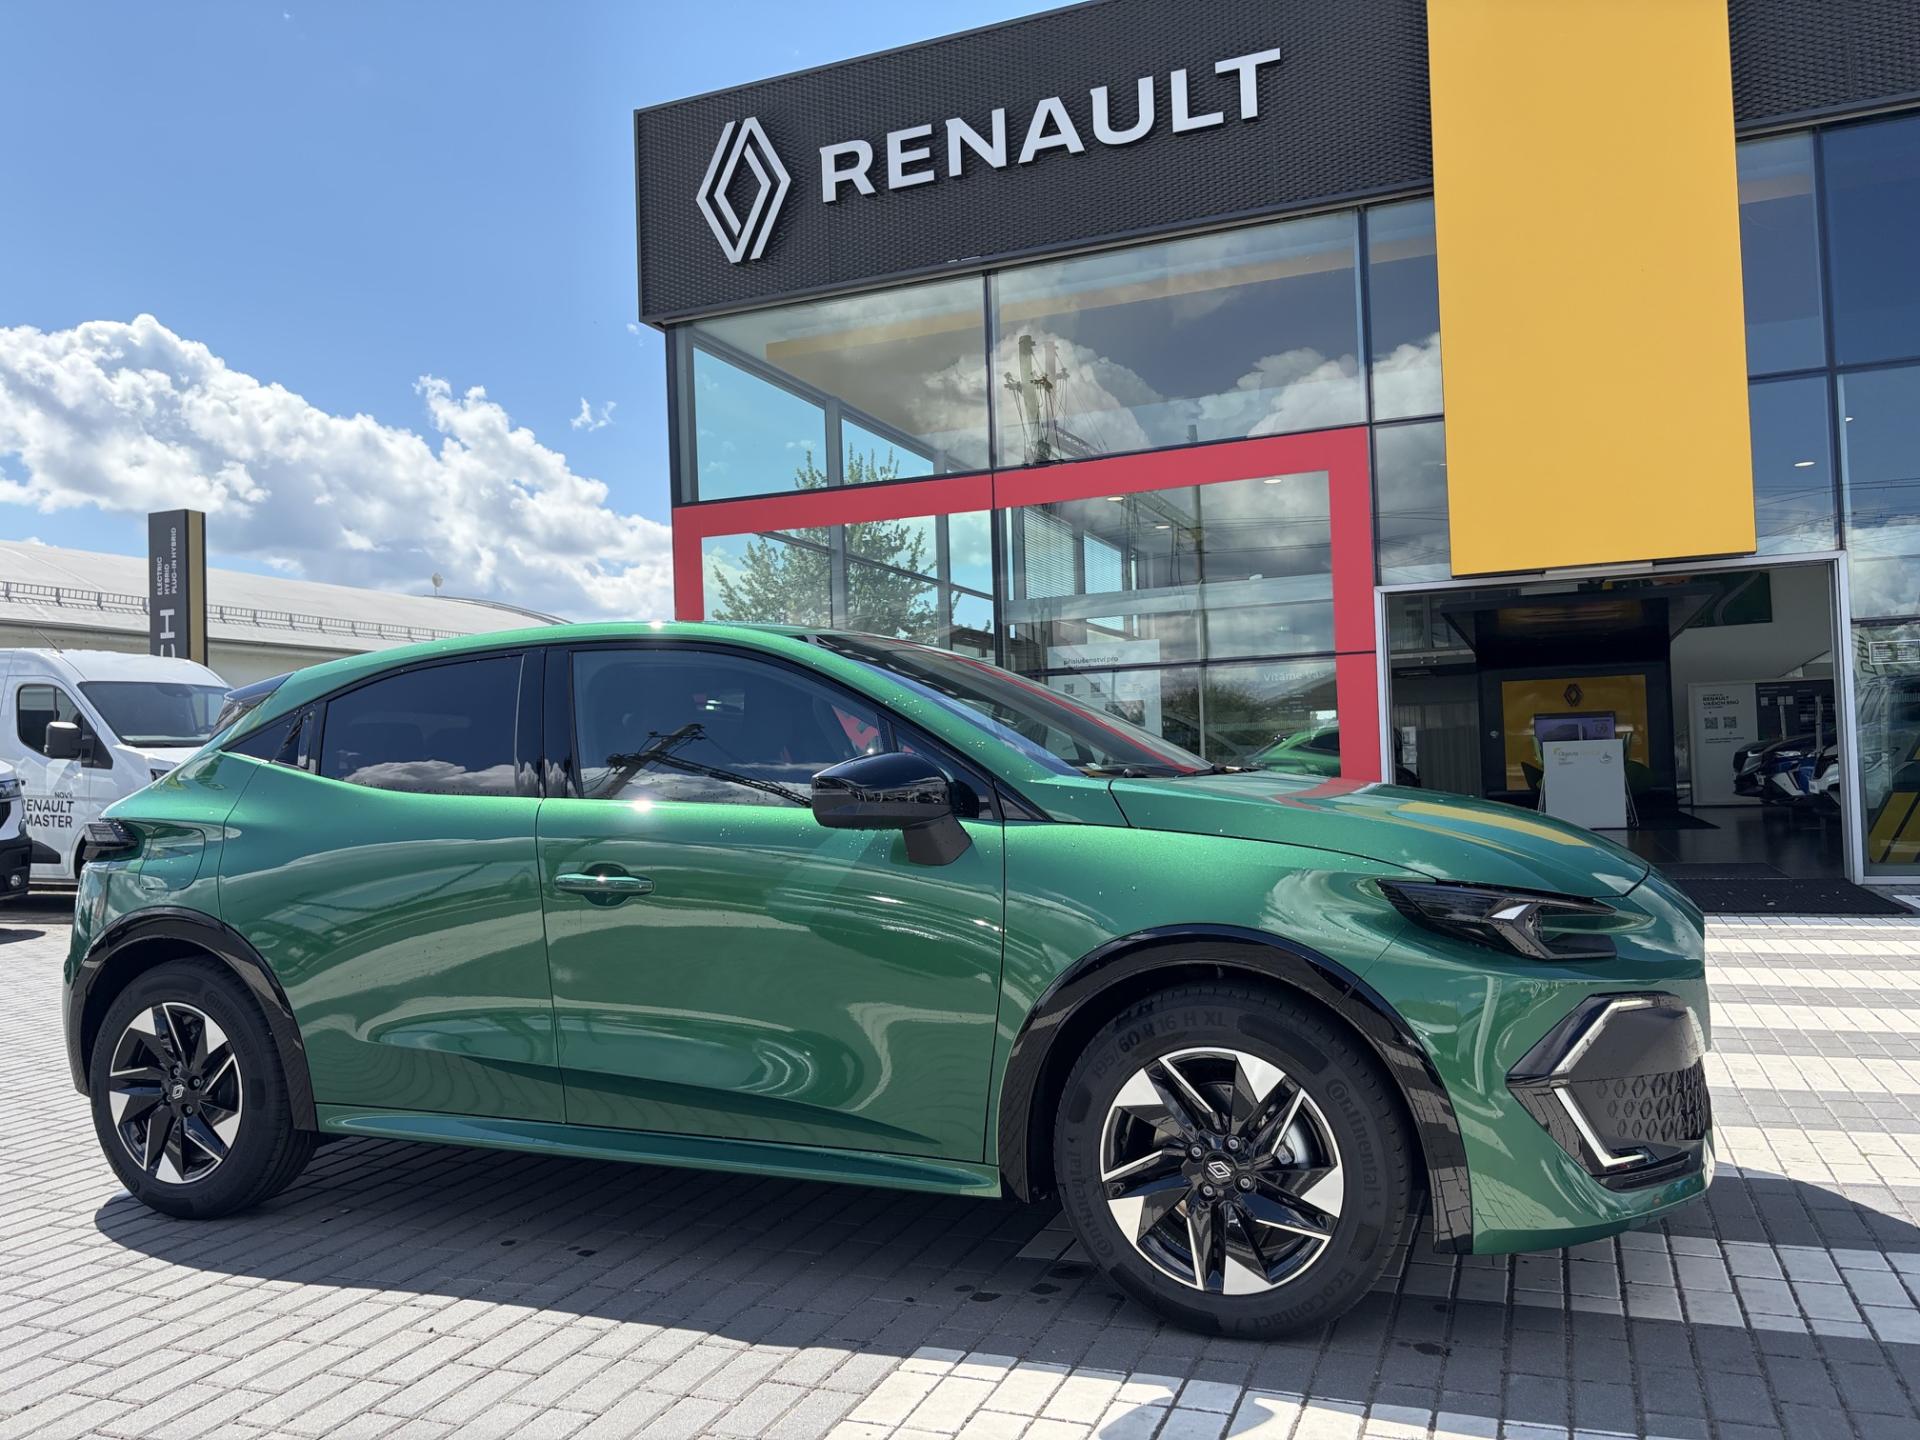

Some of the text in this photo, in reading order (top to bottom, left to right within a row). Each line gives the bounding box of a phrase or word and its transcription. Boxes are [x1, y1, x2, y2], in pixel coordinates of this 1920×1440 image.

[819, 48, 1281, 203] RENAULT
[24, 799, 75, 813] ENAULT
[1183, 1010, 1199, 1028] H
[1204, 1010, 1228, 1028] XL
[1325, 1079, 1382, 1193] Continental
